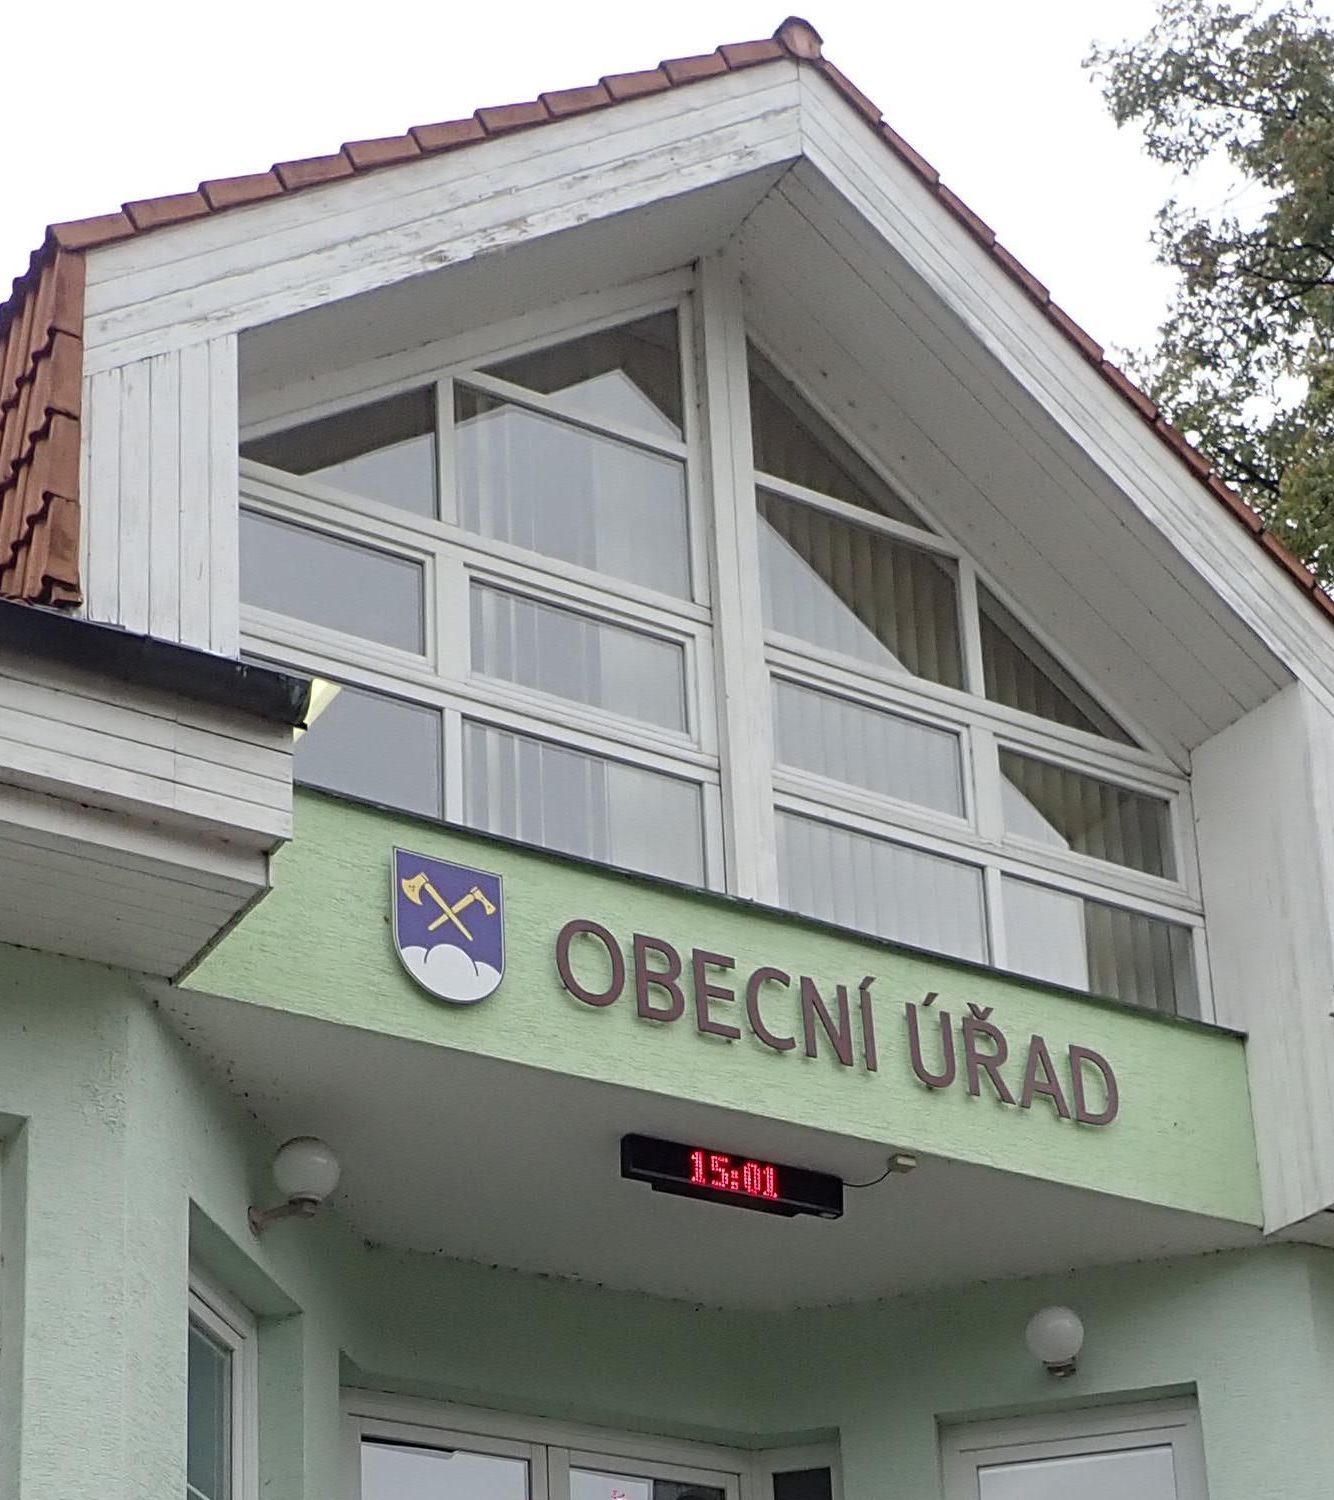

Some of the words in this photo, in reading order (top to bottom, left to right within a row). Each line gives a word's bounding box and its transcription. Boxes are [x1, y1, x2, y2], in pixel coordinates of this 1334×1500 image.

[555, 918, 878, 1073] OBECNÍ
[907, 991, 1119, 1127] ÚŘAD
[690, 1151, 778, 1199] 15:01
